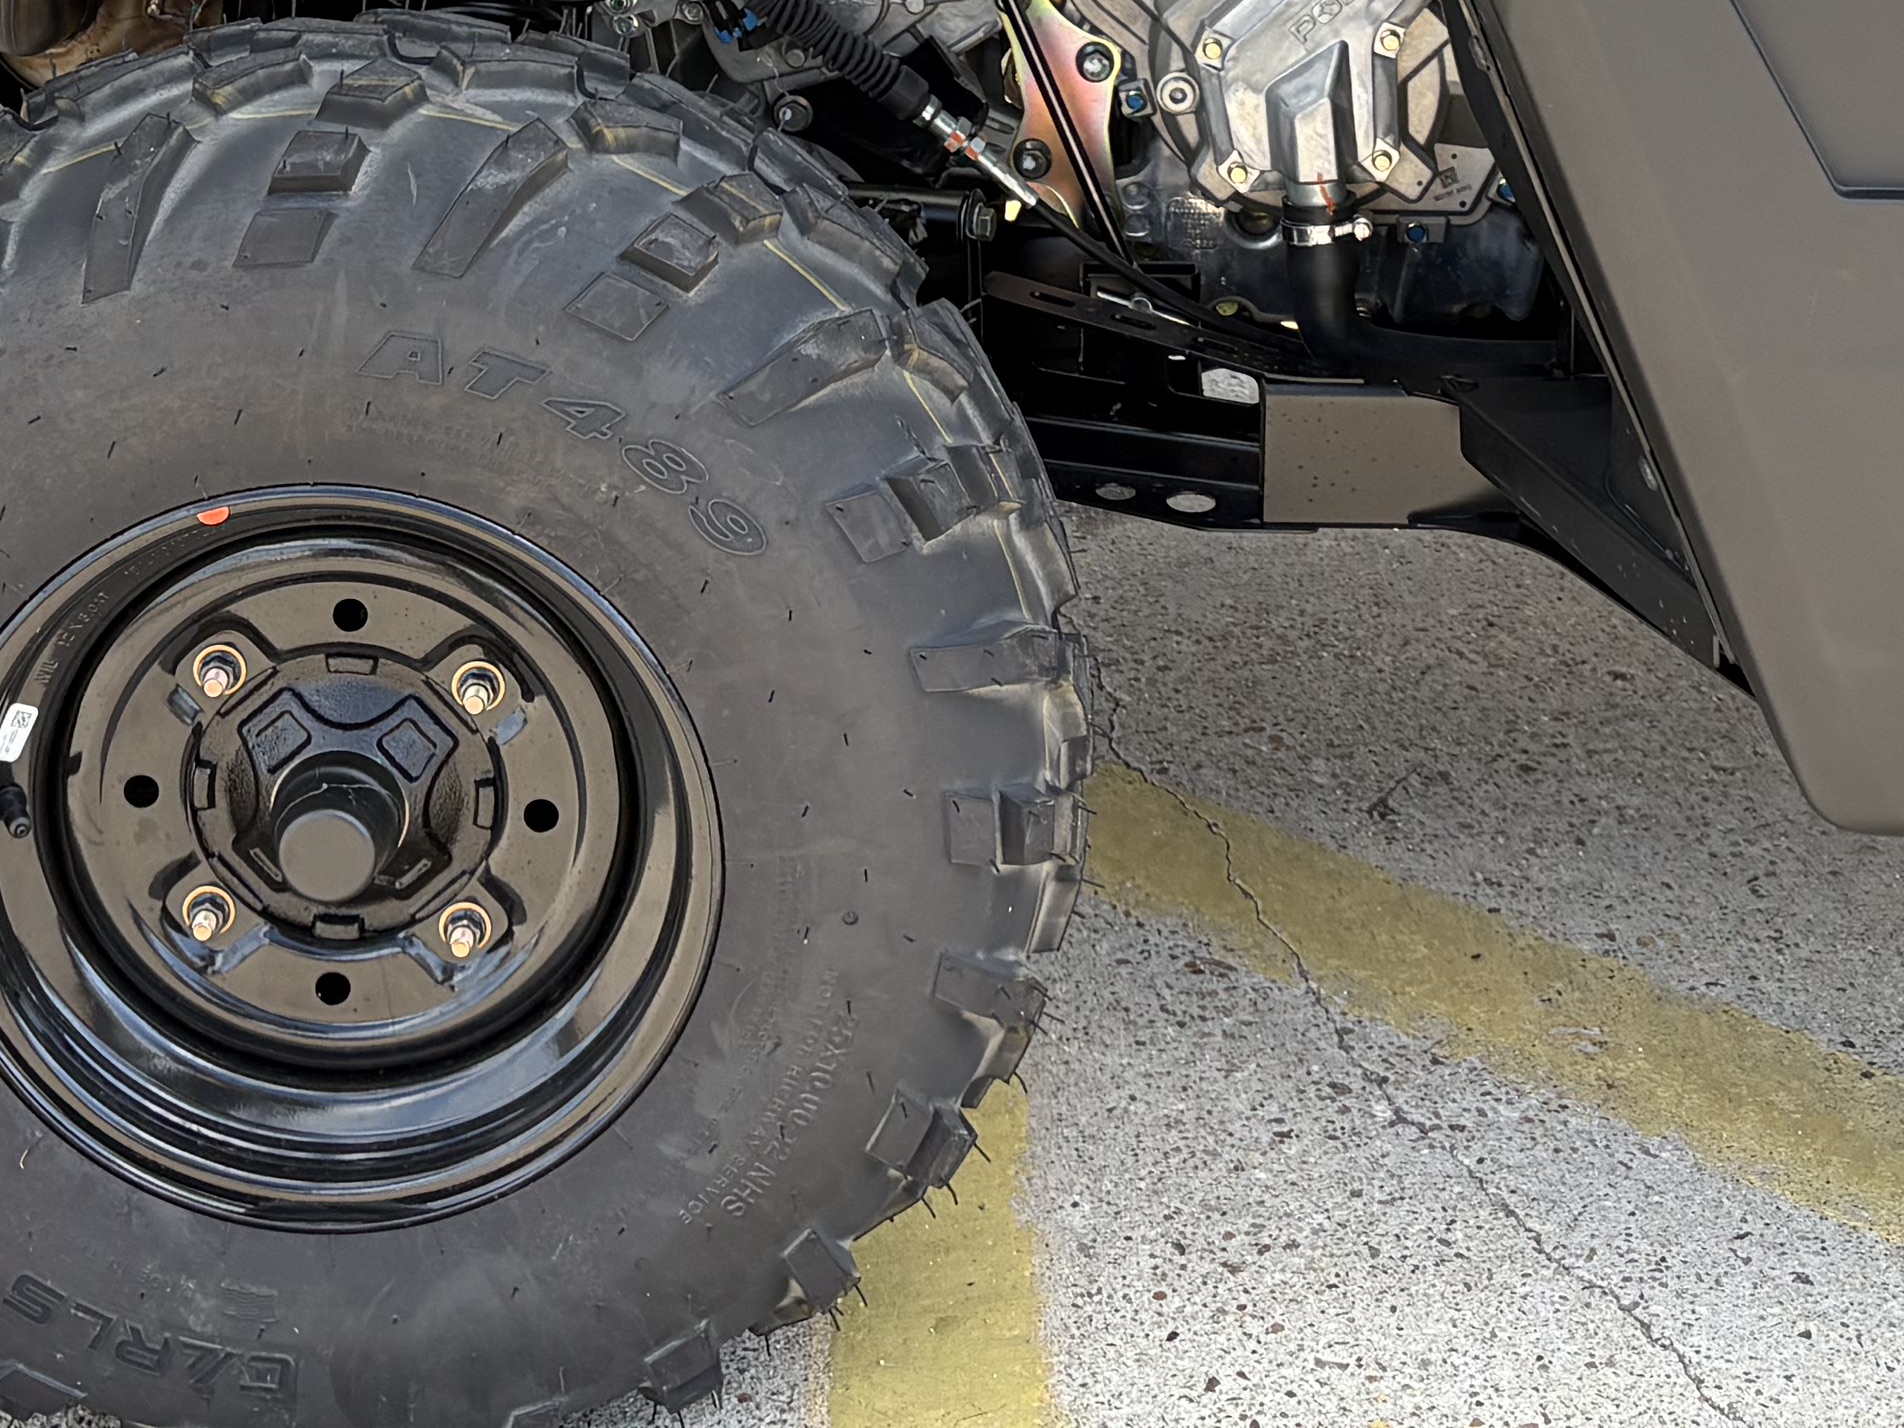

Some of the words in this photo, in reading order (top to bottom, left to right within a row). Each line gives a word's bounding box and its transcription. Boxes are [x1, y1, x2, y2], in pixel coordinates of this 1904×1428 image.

[353, 329, 552, 400] AT
[539, 395, 769, 556] 489
[742, 1062, 803, 1152] HIGHWAY
[674, 1148, 748, 1230] SERVICE
[716, 1157, 778, 1224] NHS
